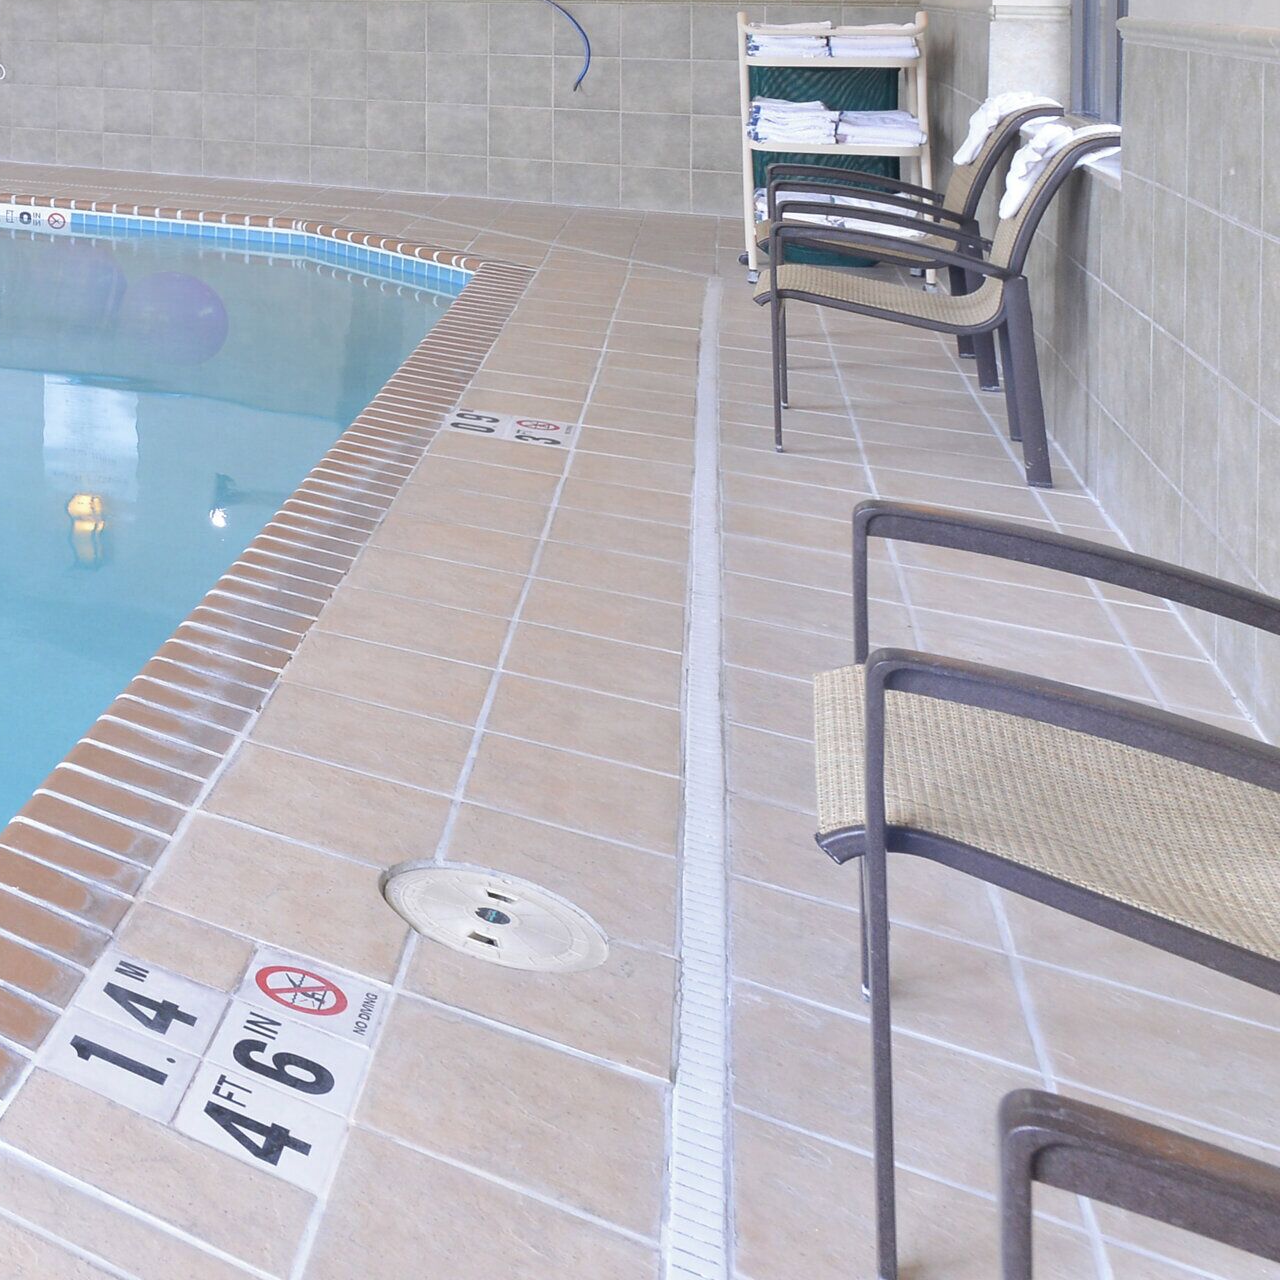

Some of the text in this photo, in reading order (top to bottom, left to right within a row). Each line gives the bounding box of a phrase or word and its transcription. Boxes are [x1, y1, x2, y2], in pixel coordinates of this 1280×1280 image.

[69, 960, 198, 1087] 1.4 M
[352, 992, 378, 1037] NO DIVING
